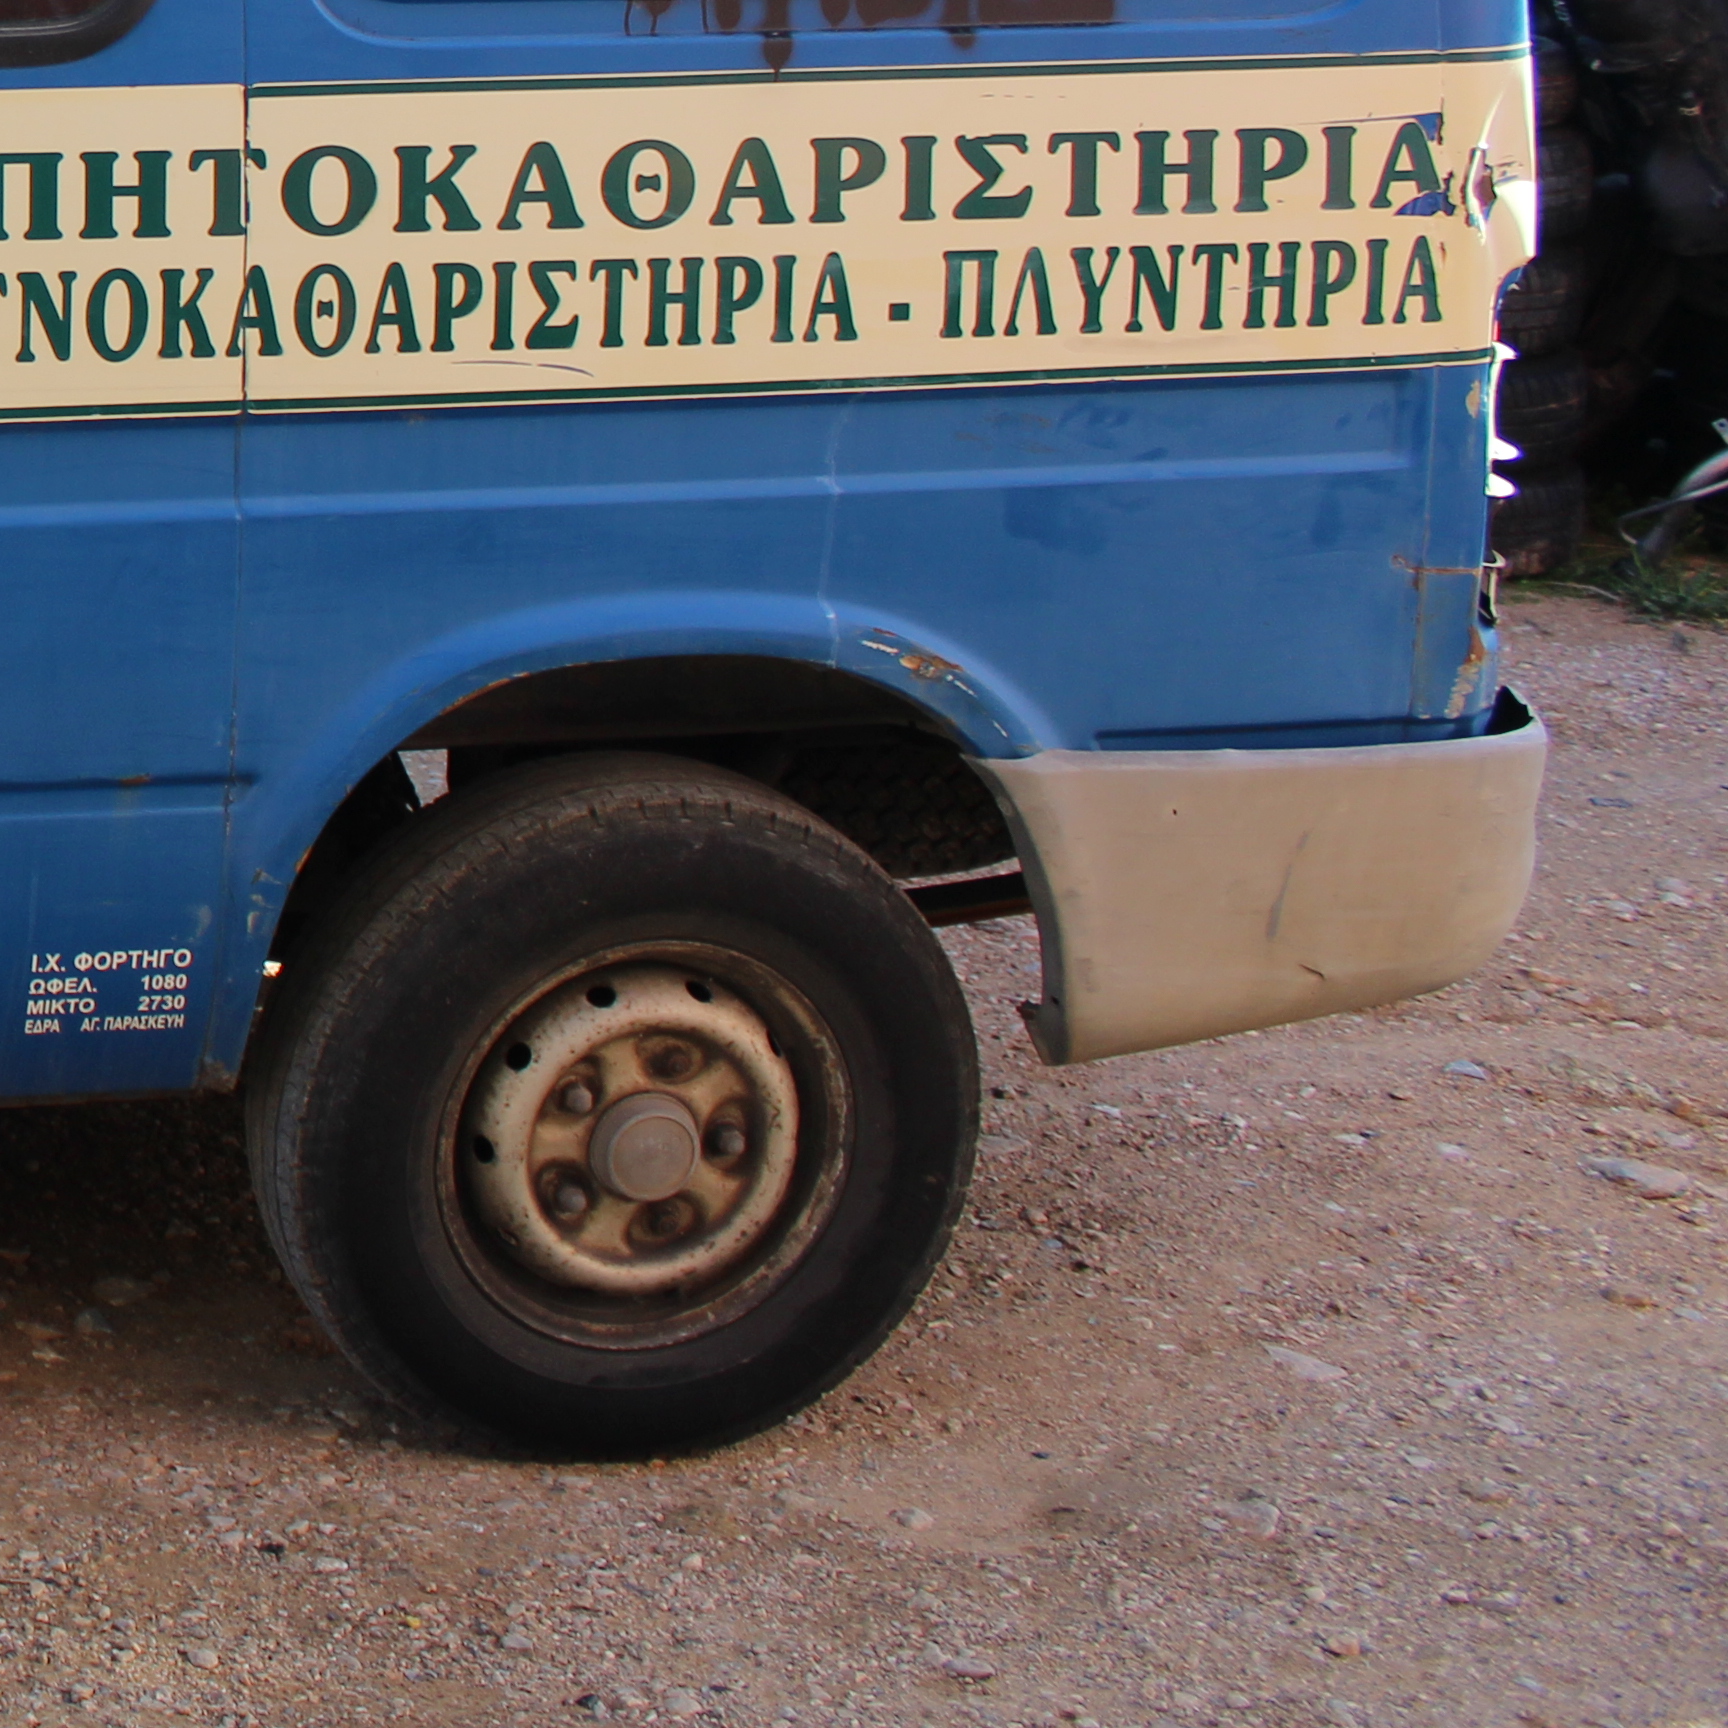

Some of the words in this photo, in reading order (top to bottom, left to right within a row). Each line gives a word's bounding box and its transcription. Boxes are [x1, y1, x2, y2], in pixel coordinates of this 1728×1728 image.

[940, 235, 1443, 339] ΠΛΥΝΤΗΡΙΑ
[74, 948, 192, 972] ΦΟΡΤΗΓΟ
[28, 977, 97, 995] ΩΦΕΛ.
[140, 973, 188, 991] 1080
[26, 998, 96, 1015] ΜΙΚΤΟ
[138, 994, 186, 1012] 2730
[24, 1019, 61, 1035] ΕΔΡΑ
[103, 1014, 185, 1031] ΠΑΡΑΣΚΕΥΗ
